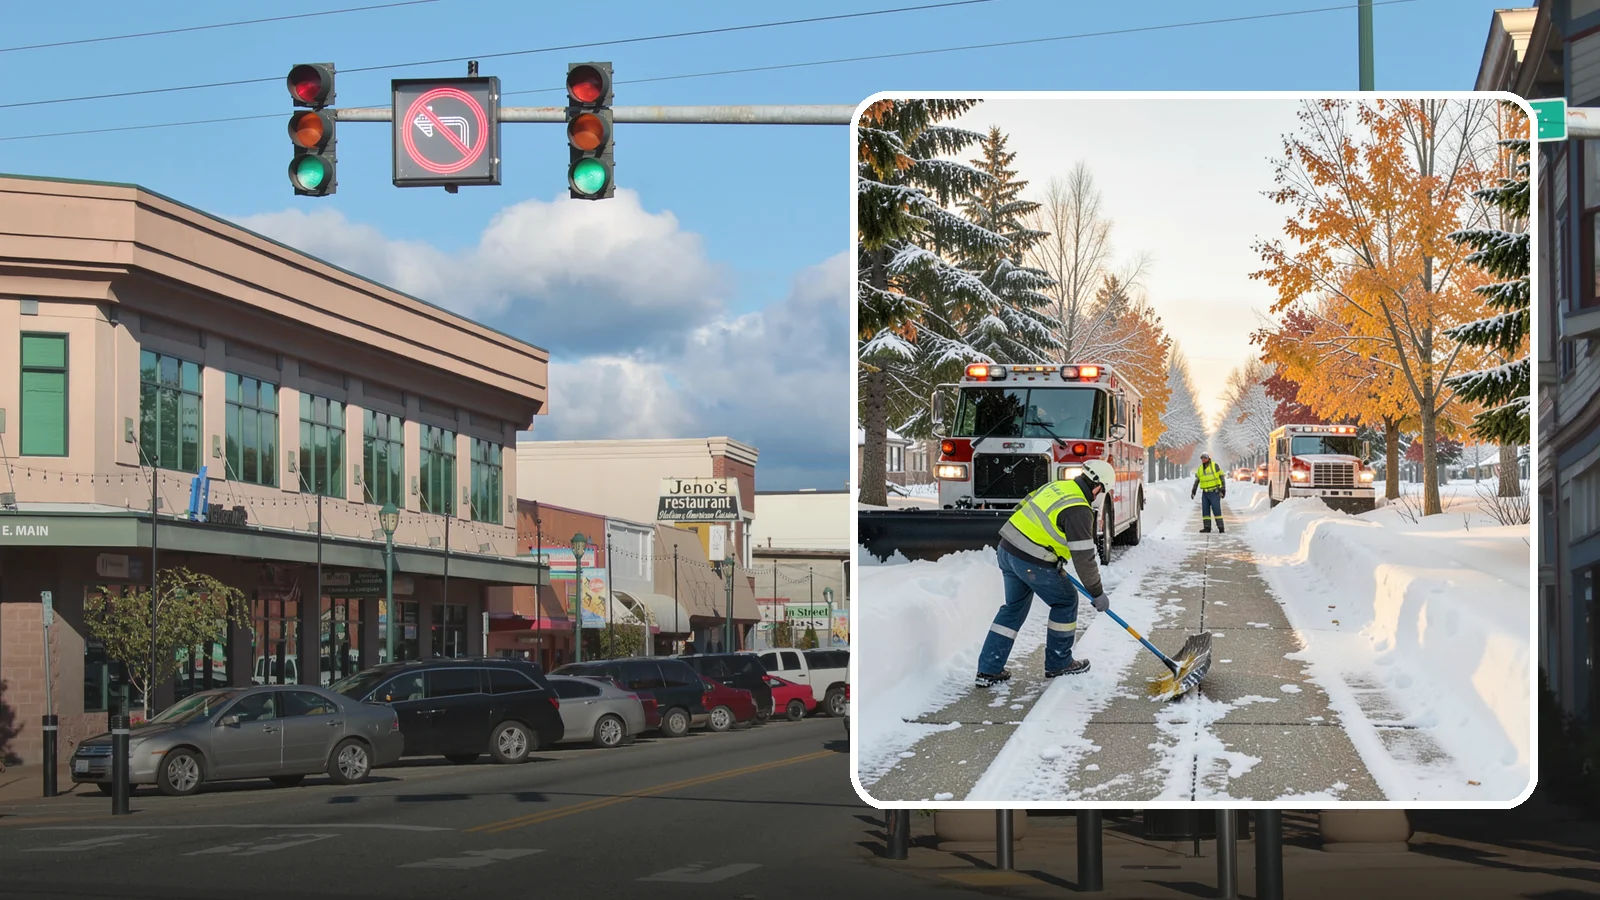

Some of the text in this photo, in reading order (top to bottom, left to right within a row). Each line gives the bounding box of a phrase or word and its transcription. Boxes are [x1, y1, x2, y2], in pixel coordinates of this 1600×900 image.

[670, 480, 727, 494] Jeno's
[665, 496, 731, 509] restaurant
[658, 510, 682, 519] Italian
[686, 509, 714, 519] American
[714, 509, 738, 519] Cuisine
[2, 525, 49, 536] E. MAIN
[797, 607, 828, 617] Street
